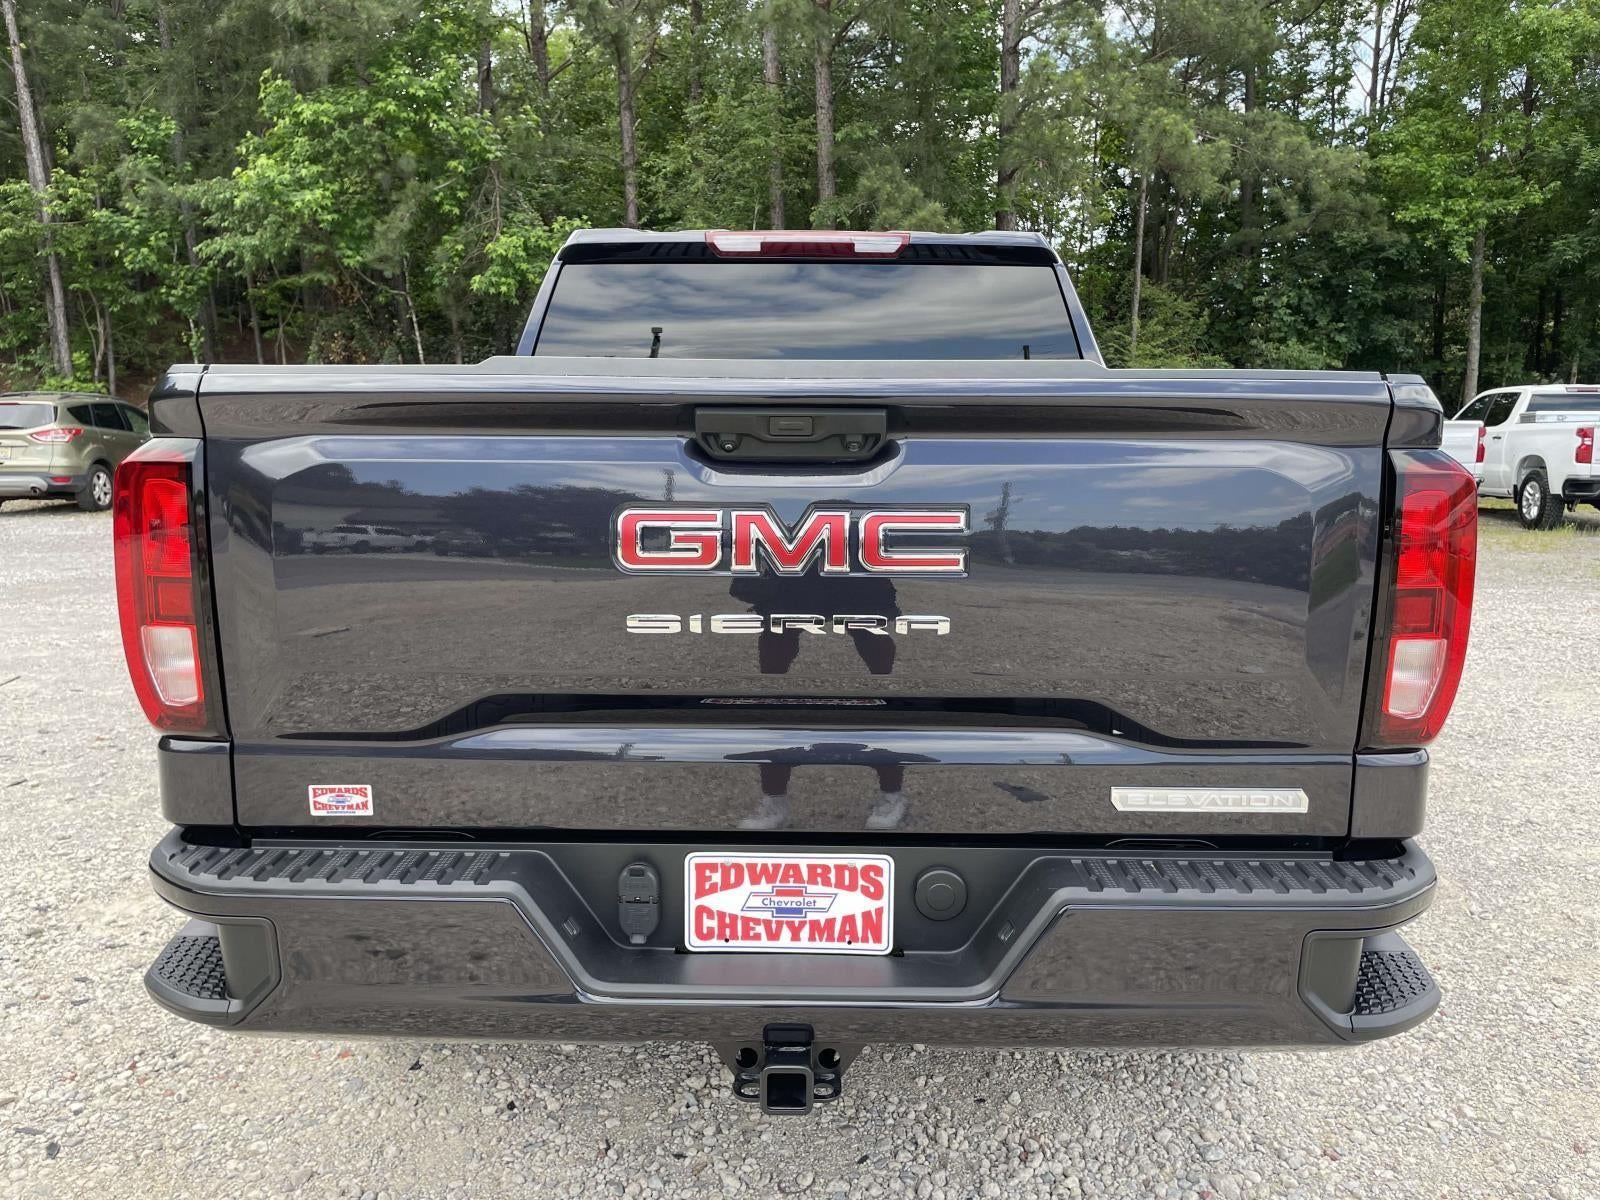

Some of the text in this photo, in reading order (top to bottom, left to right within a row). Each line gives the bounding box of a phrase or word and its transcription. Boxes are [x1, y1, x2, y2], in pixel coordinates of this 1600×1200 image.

[616, 507, 970, 577] GMC
[626, 614, 951, 635] SIERRA
[312, 787, 369, 798] EDWARDS
[1127, 793, 1294, 808] ELEVATION
[313, 800, 369, 811] CHEVYMAN
[694, 862, 884, 901] EDWARDS
[761, 897, 817, 907] Chevrolet
[694, 904, 884, 944] CHEVYMAN
